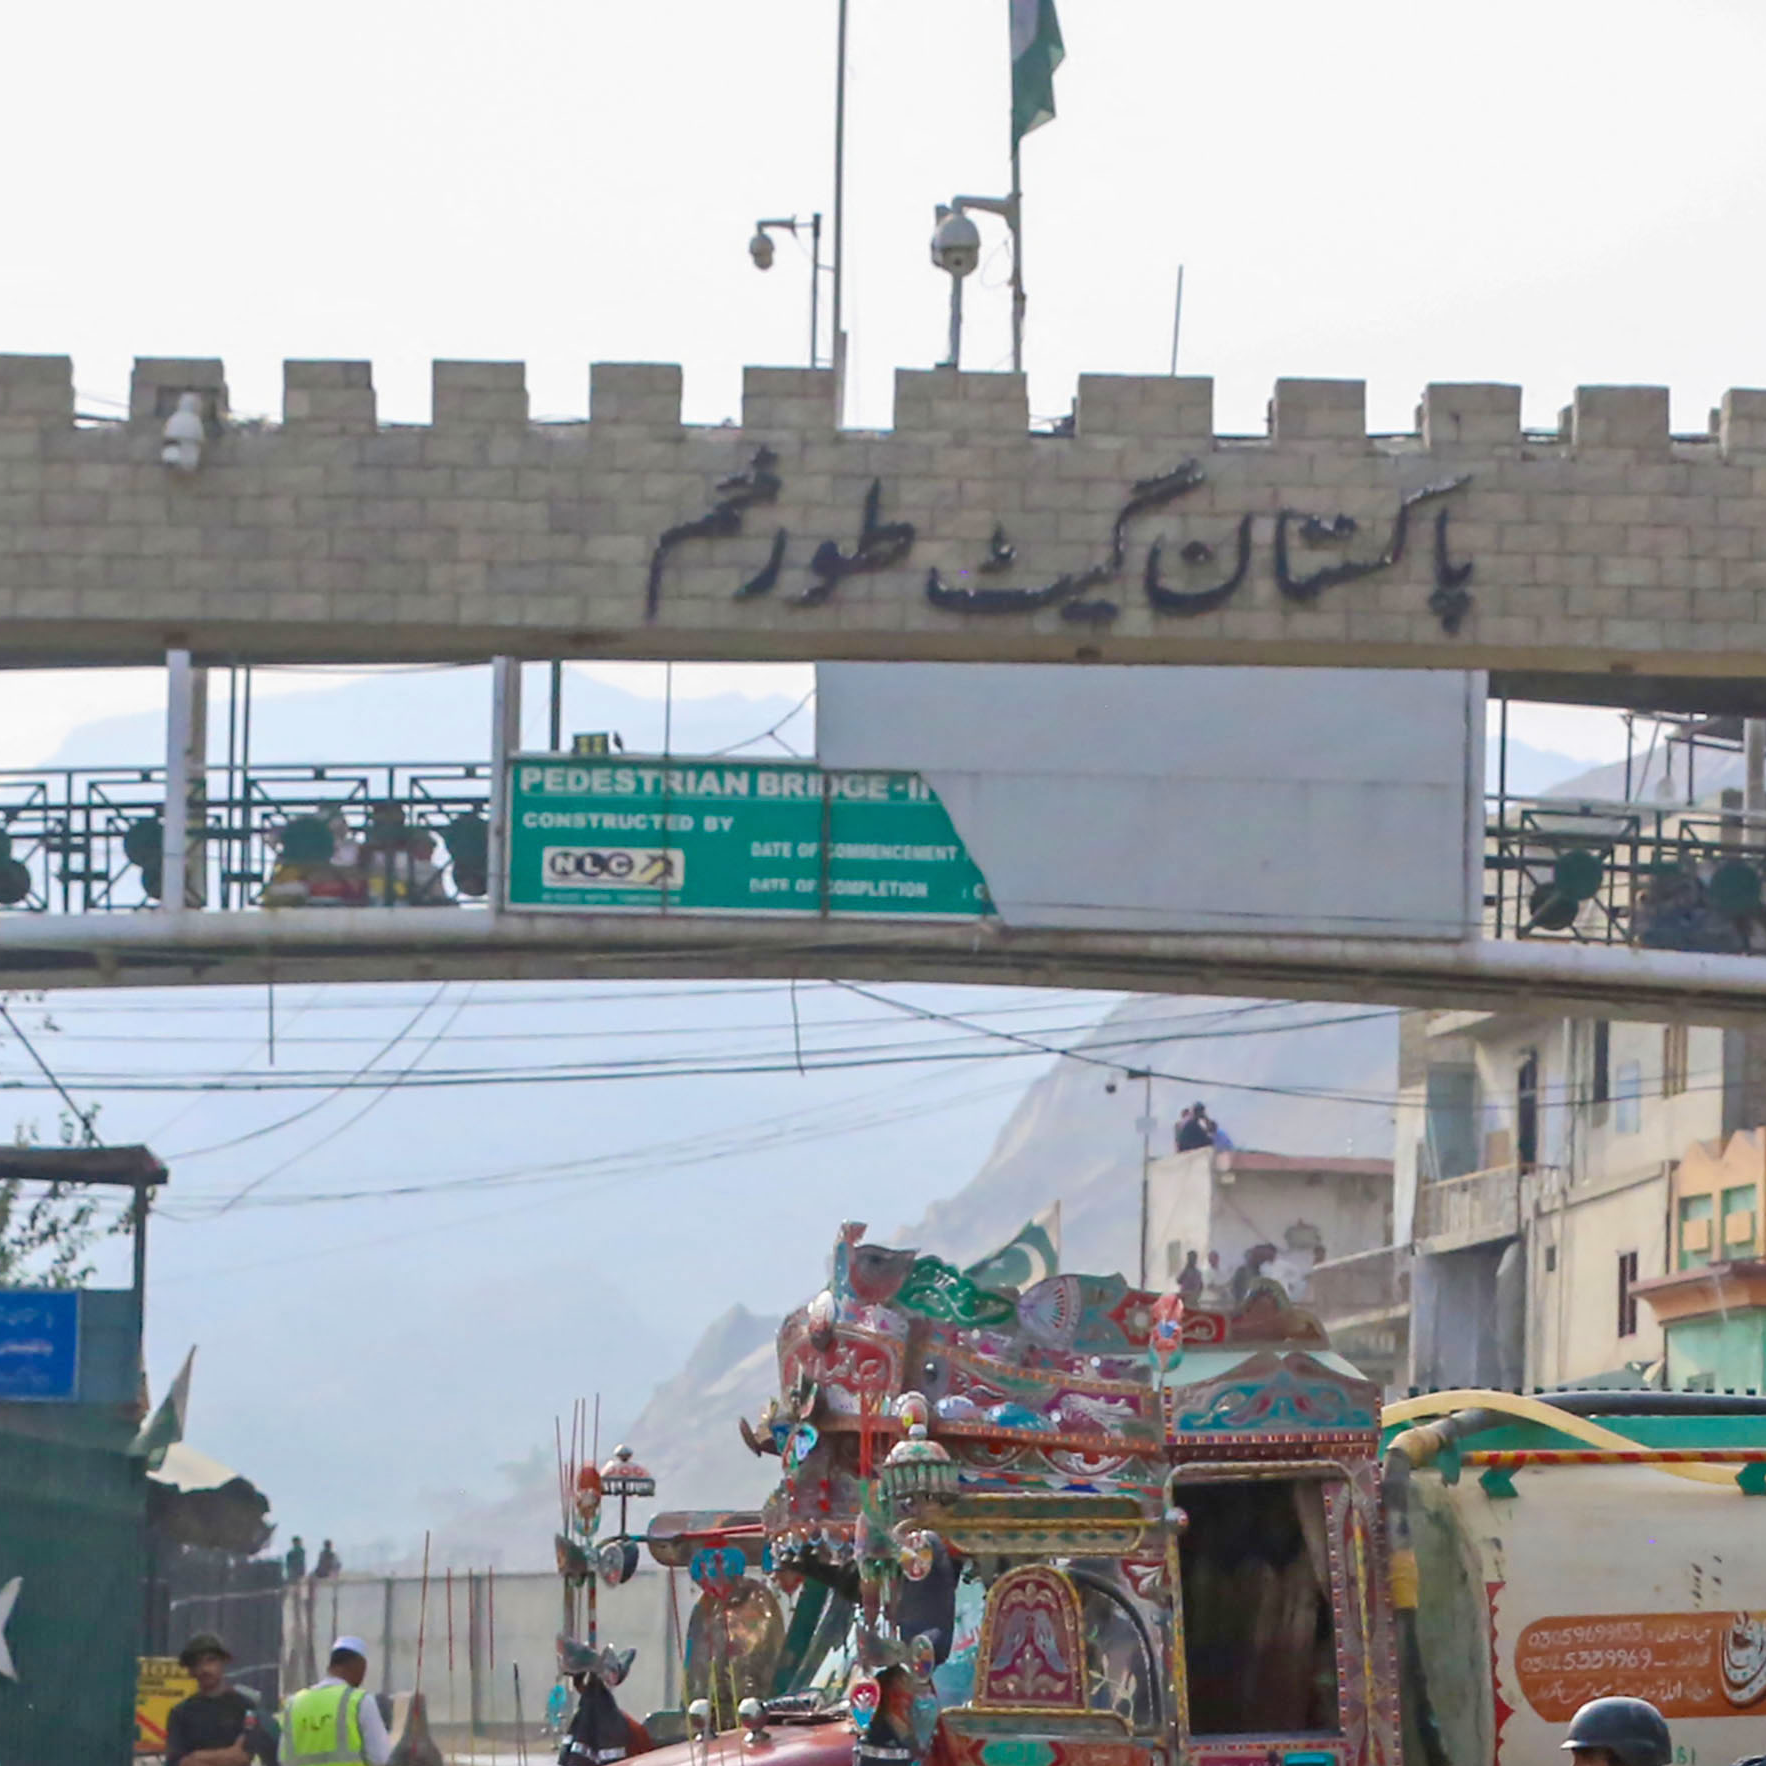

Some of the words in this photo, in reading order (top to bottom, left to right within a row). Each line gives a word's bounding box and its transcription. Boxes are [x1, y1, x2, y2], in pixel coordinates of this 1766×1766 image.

[644, 444, 917, 622] طورخم
[1144, 474, 1474, 636] پاکستان
[519, 766, 751, 797] PEDESTRIAN
[756, 771, 890, 800] BRIDGE
[522, 810, 695, 832] CONSTRUCTED
[703, 816, 734, 833] BY
[750, 840, 792, 858] DATE
[797, 841, 819, 858] OF
[551, 853, 633, 876] NLC
[749, 877, 790, 894] DATE
[795, 878, 818, 894] OF
